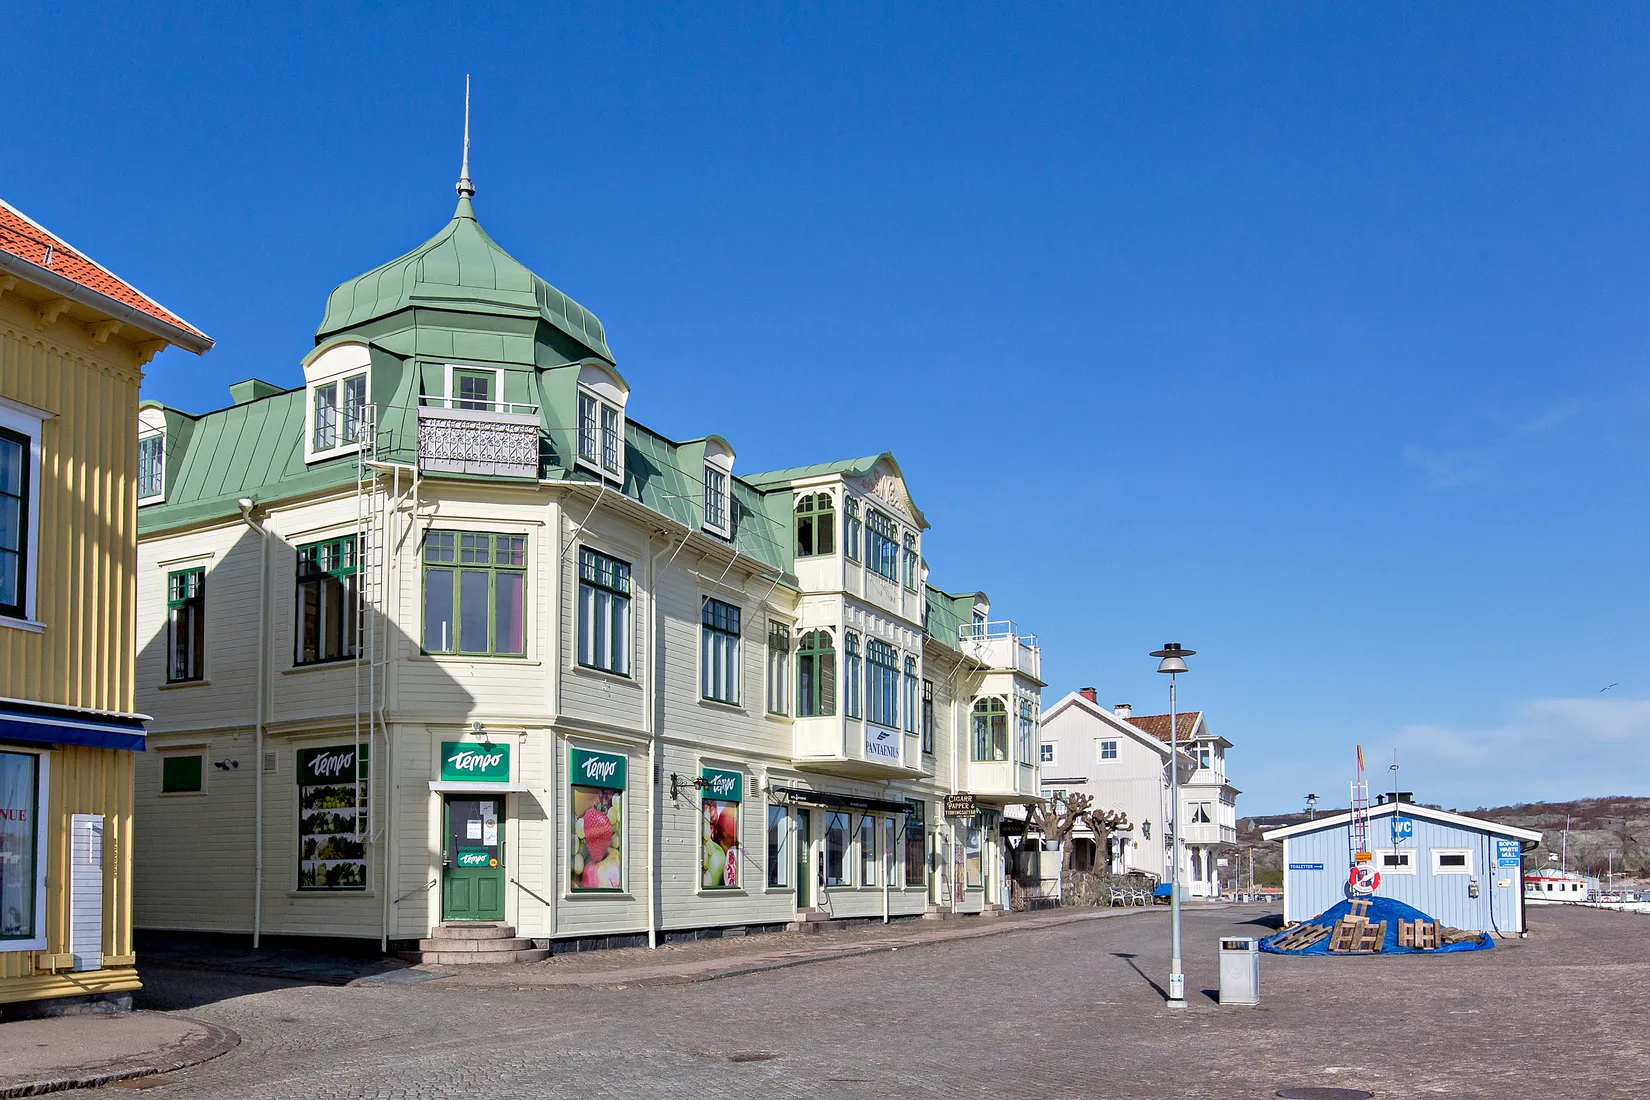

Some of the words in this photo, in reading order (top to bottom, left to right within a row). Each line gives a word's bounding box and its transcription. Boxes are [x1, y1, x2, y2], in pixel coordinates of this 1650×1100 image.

[866, 740, 899, 759] PANTAENIUS
[948, 795, 973, 803] CIGARR
[946, 802, 970, 810] PAPPER
[1391, 821, 1411, 833] WC
